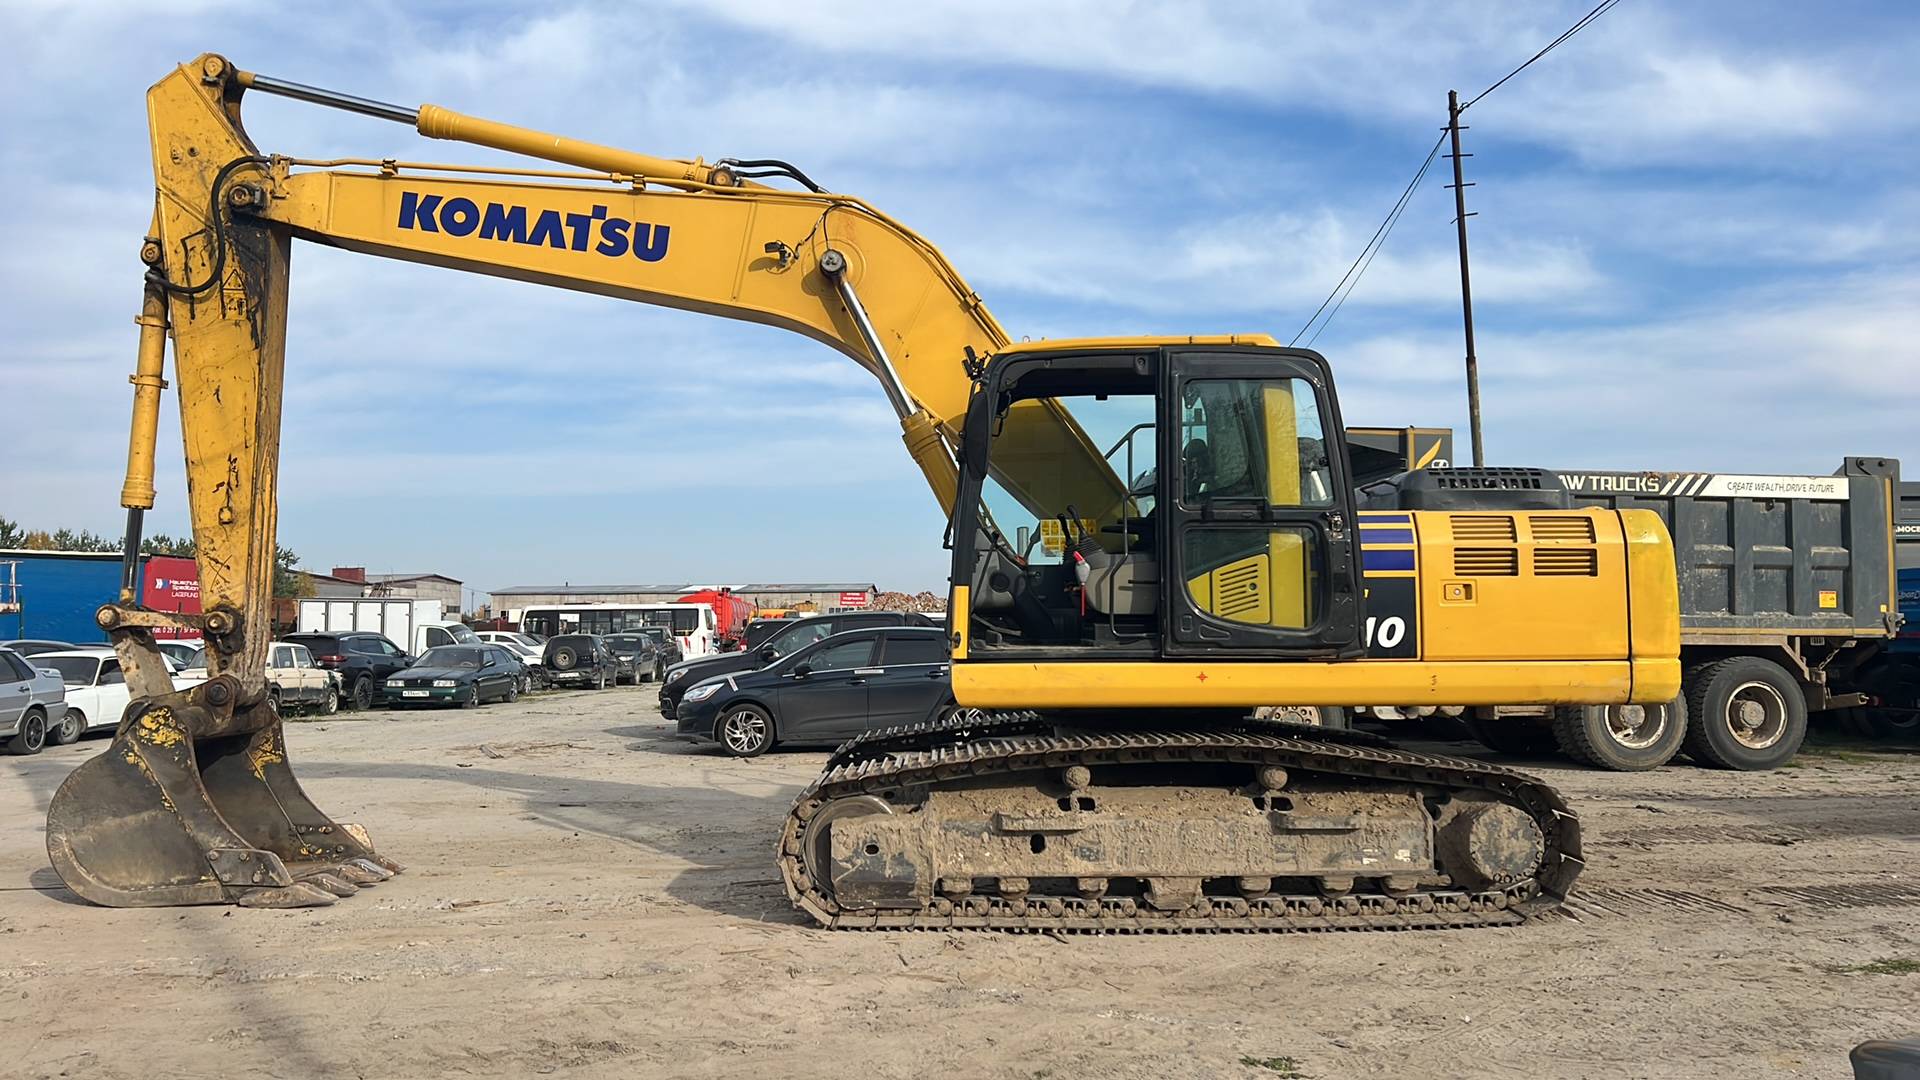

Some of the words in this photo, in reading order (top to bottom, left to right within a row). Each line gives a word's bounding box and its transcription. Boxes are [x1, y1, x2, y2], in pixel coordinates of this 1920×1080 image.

[398, 191, 671, 263] KOMATSU
[1589, 476, 1660, 492] TRUCKS
[1727, 481, 1753, 492] CREATE
[1809, 483, 1835, 493] FUTURE
